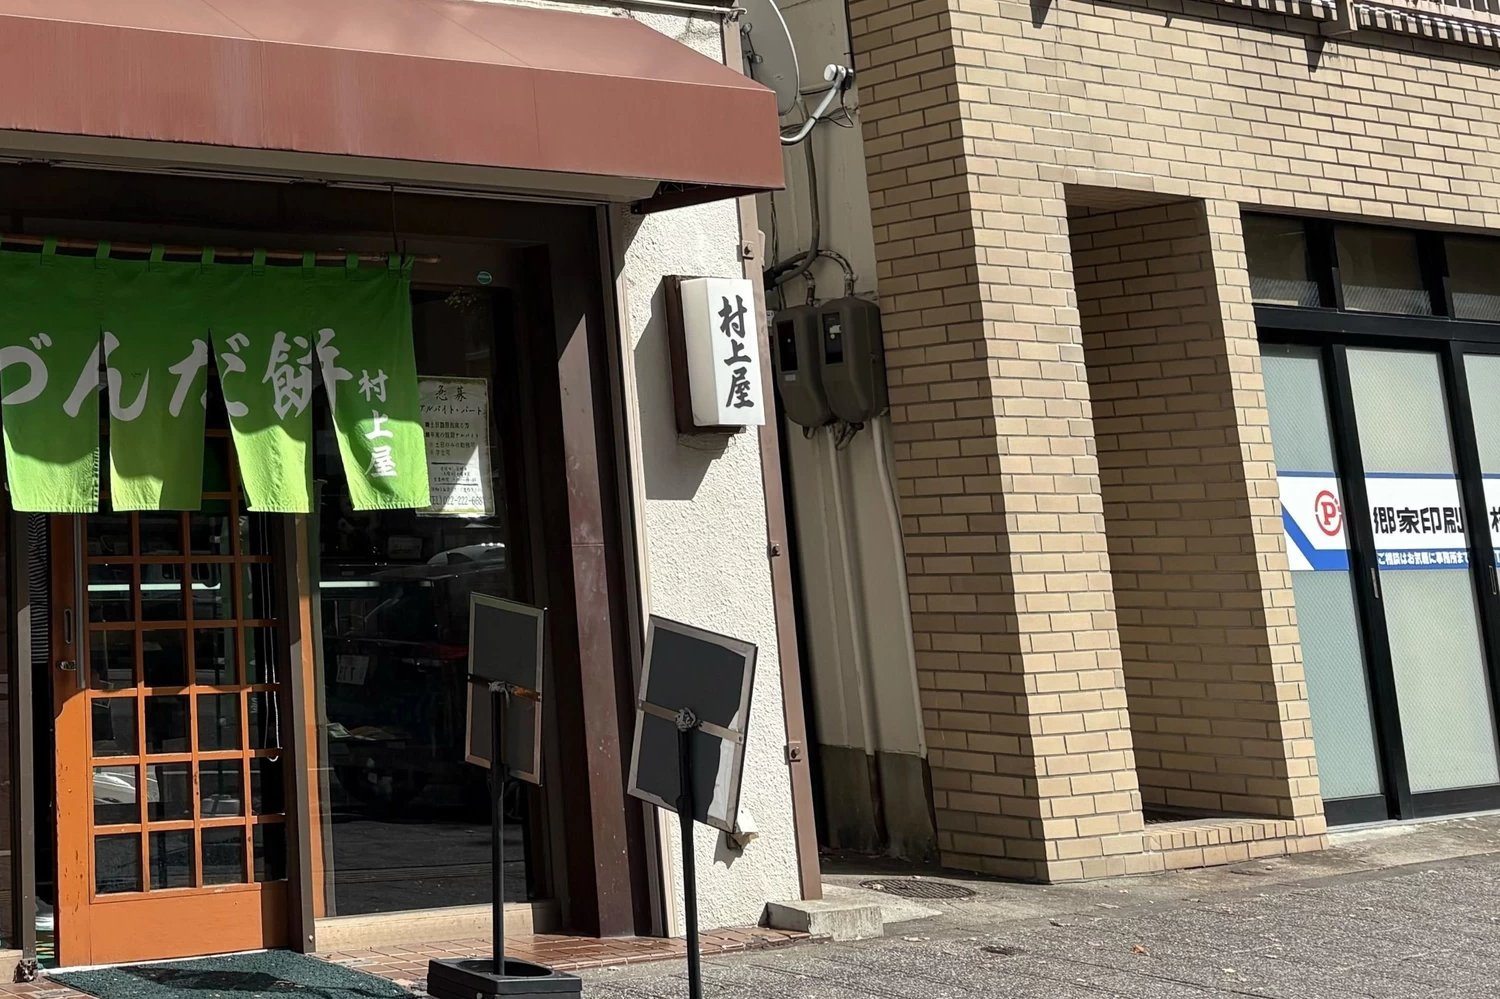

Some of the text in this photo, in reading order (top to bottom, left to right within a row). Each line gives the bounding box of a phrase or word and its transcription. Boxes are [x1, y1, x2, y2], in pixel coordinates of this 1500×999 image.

[435, 384, 467, 402] 急募
[717, 294, 755, 409] 村上屋
[358, 368, 398, 477] 村上屋
